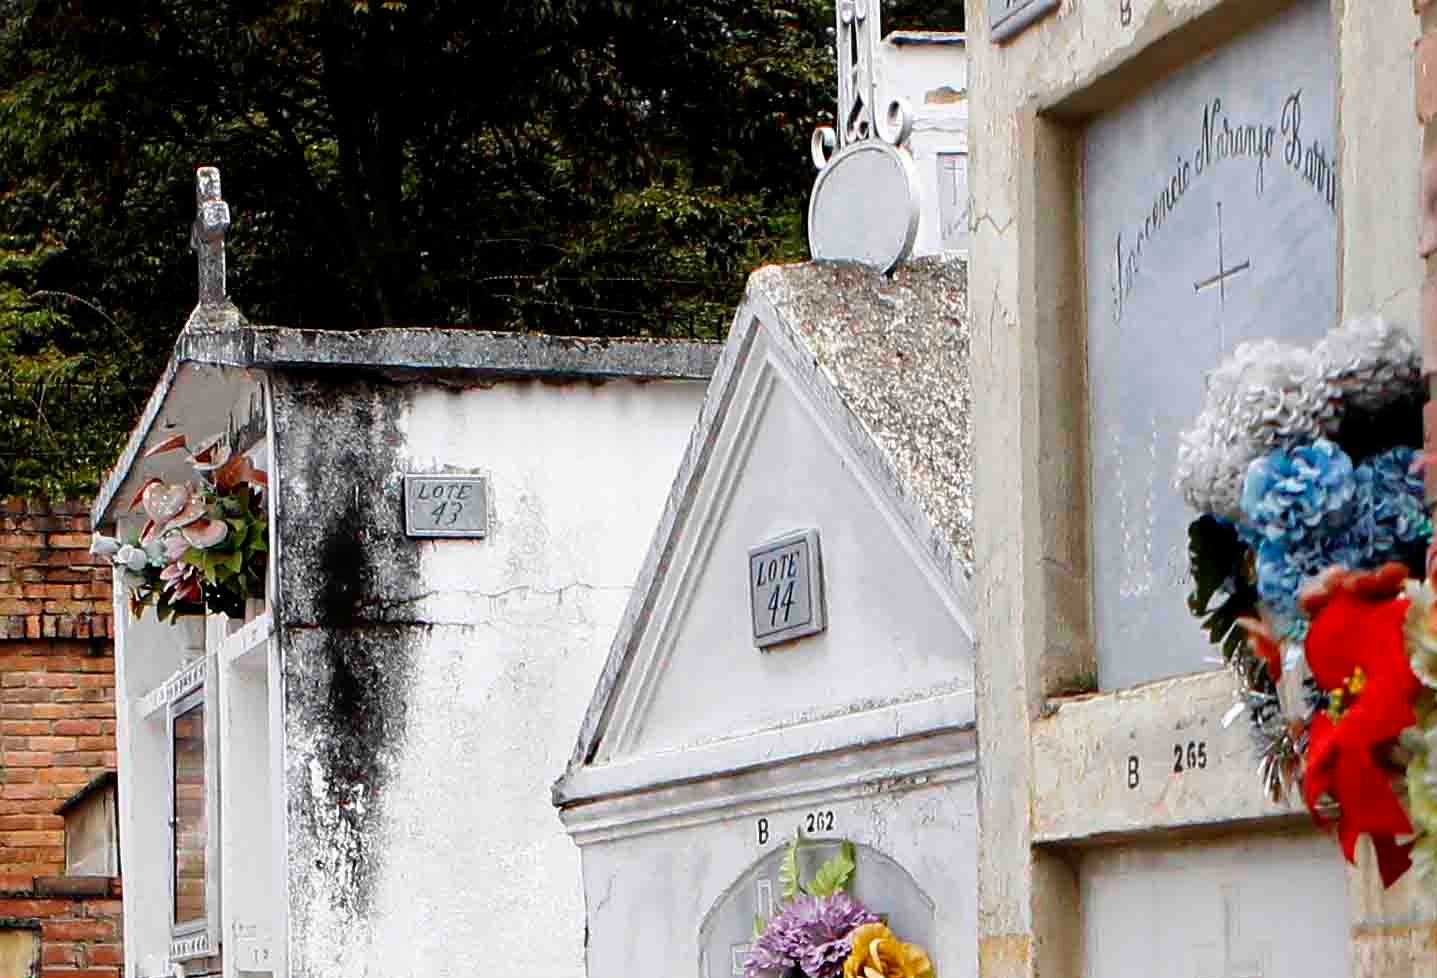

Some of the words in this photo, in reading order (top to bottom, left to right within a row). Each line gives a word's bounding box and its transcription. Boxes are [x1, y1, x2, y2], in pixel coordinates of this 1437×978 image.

[416, 481, 473, 500] LOTE
[431, 501, 464, 527] 43
[757, 550, 800, 587] LOTE
[768, 580, 796, 628] 44
[1128, 755, 1139, 789] B
[1174, 740, 1207, 774] 265
[757, 817, 769, 845] B
[806, 810, 834, 833] 262
